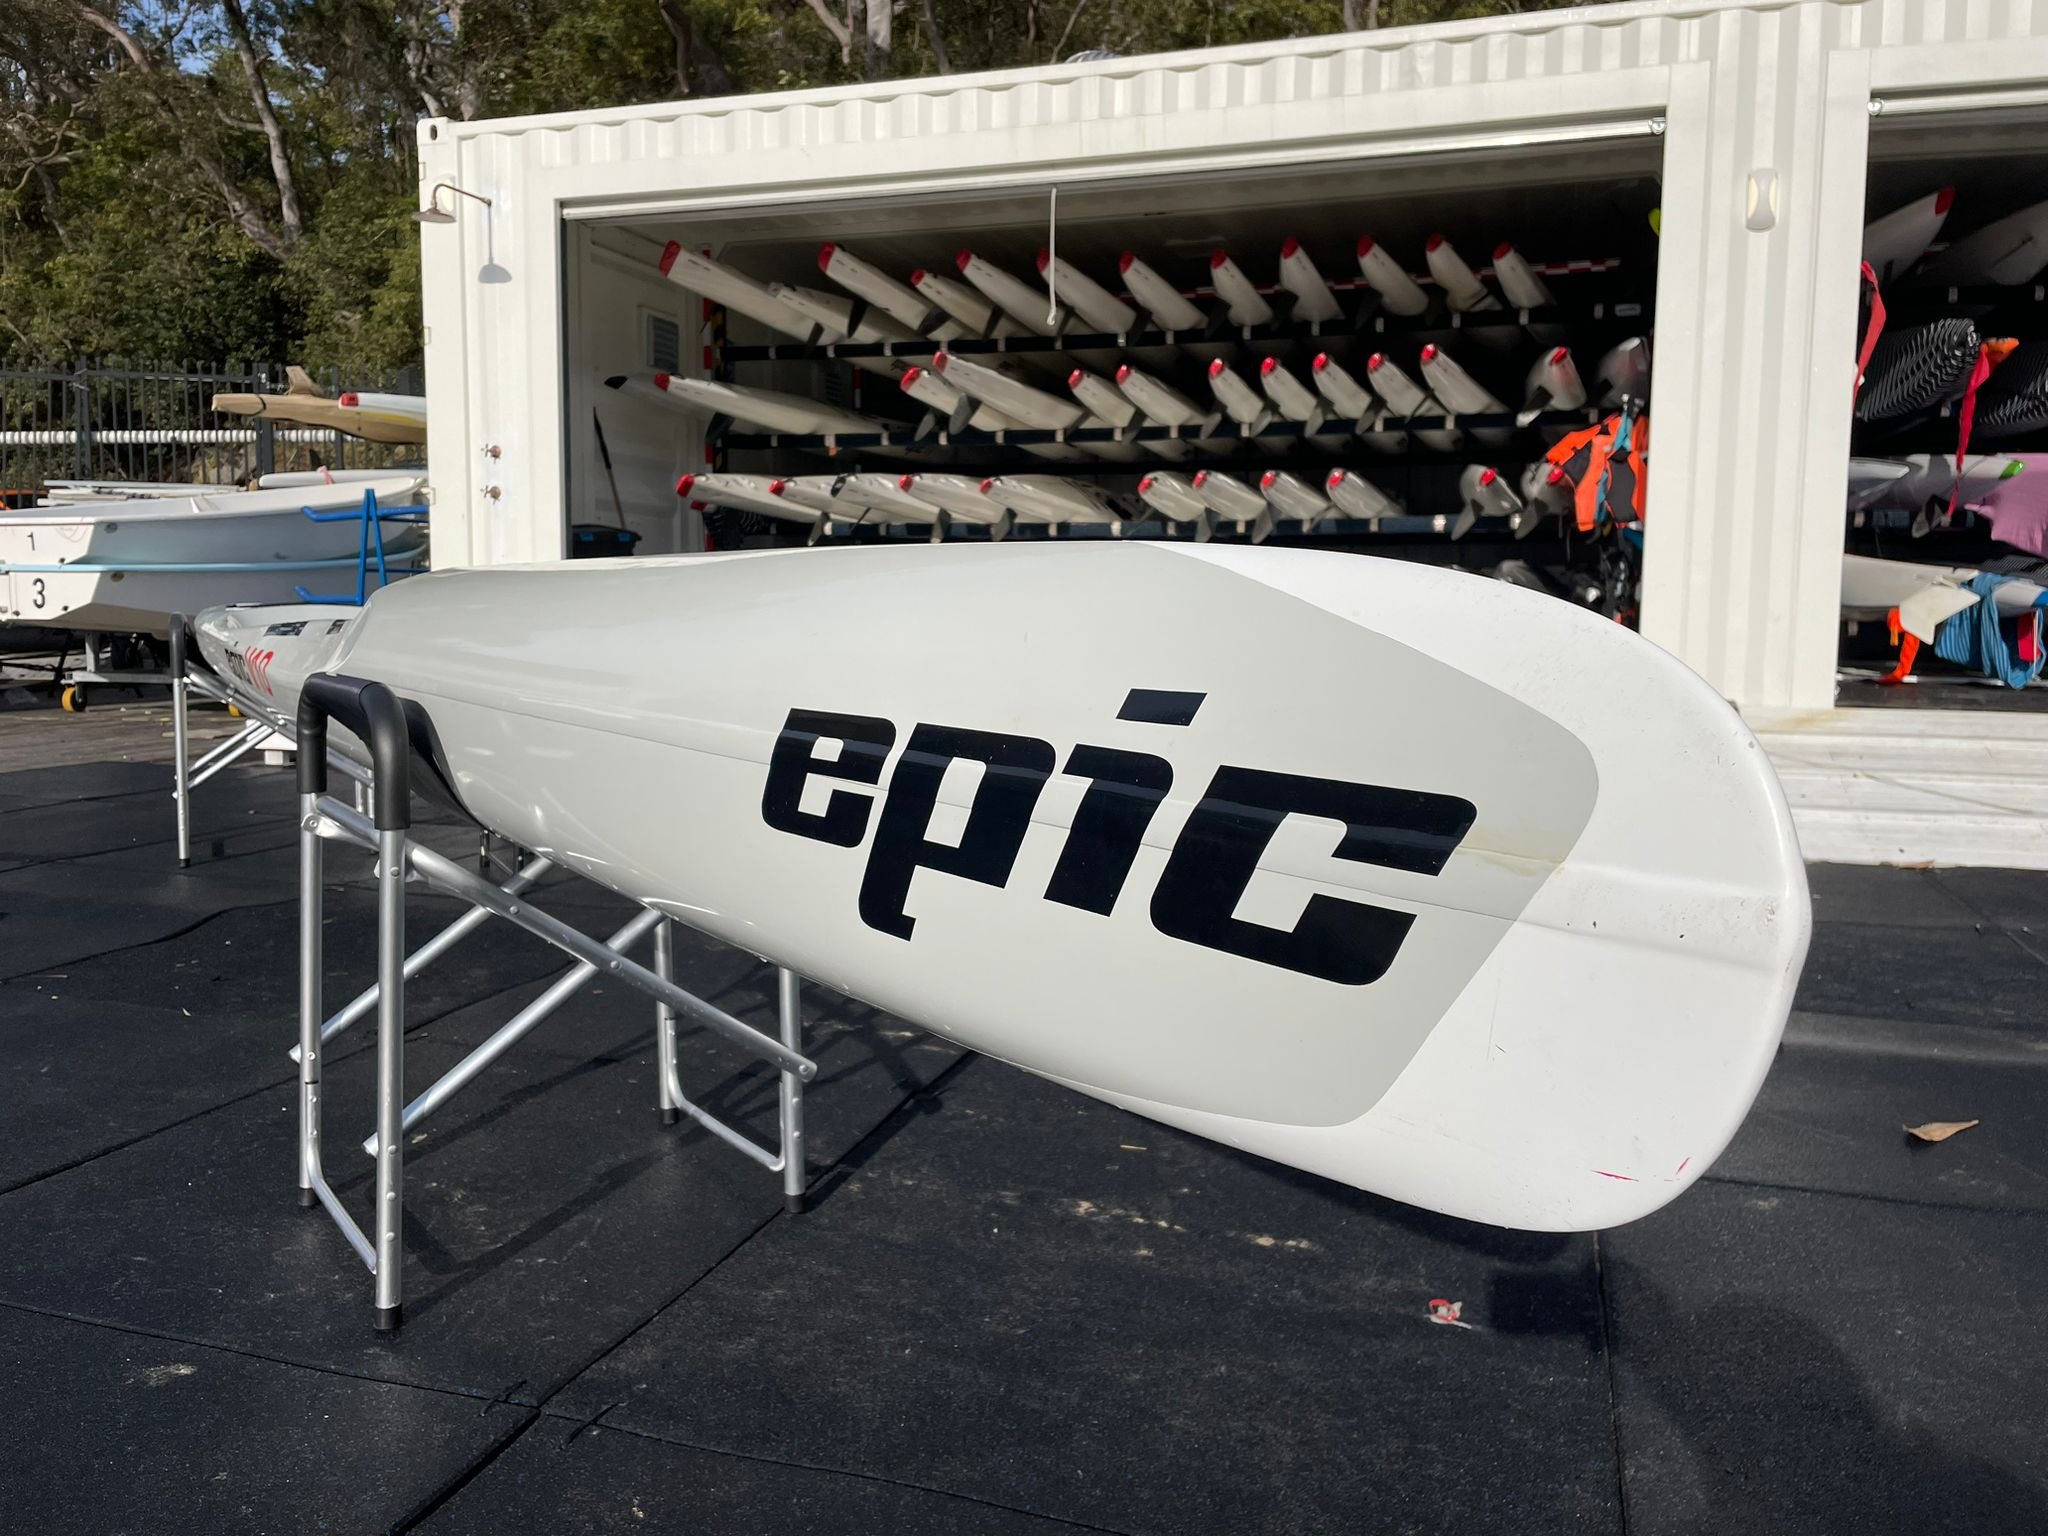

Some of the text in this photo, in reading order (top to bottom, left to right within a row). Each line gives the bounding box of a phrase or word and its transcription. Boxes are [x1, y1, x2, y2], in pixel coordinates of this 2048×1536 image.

[27, 531, 35, 551] 1
[32, 577, 46, 609] 3
[761, 687, 1478, 985] epic
